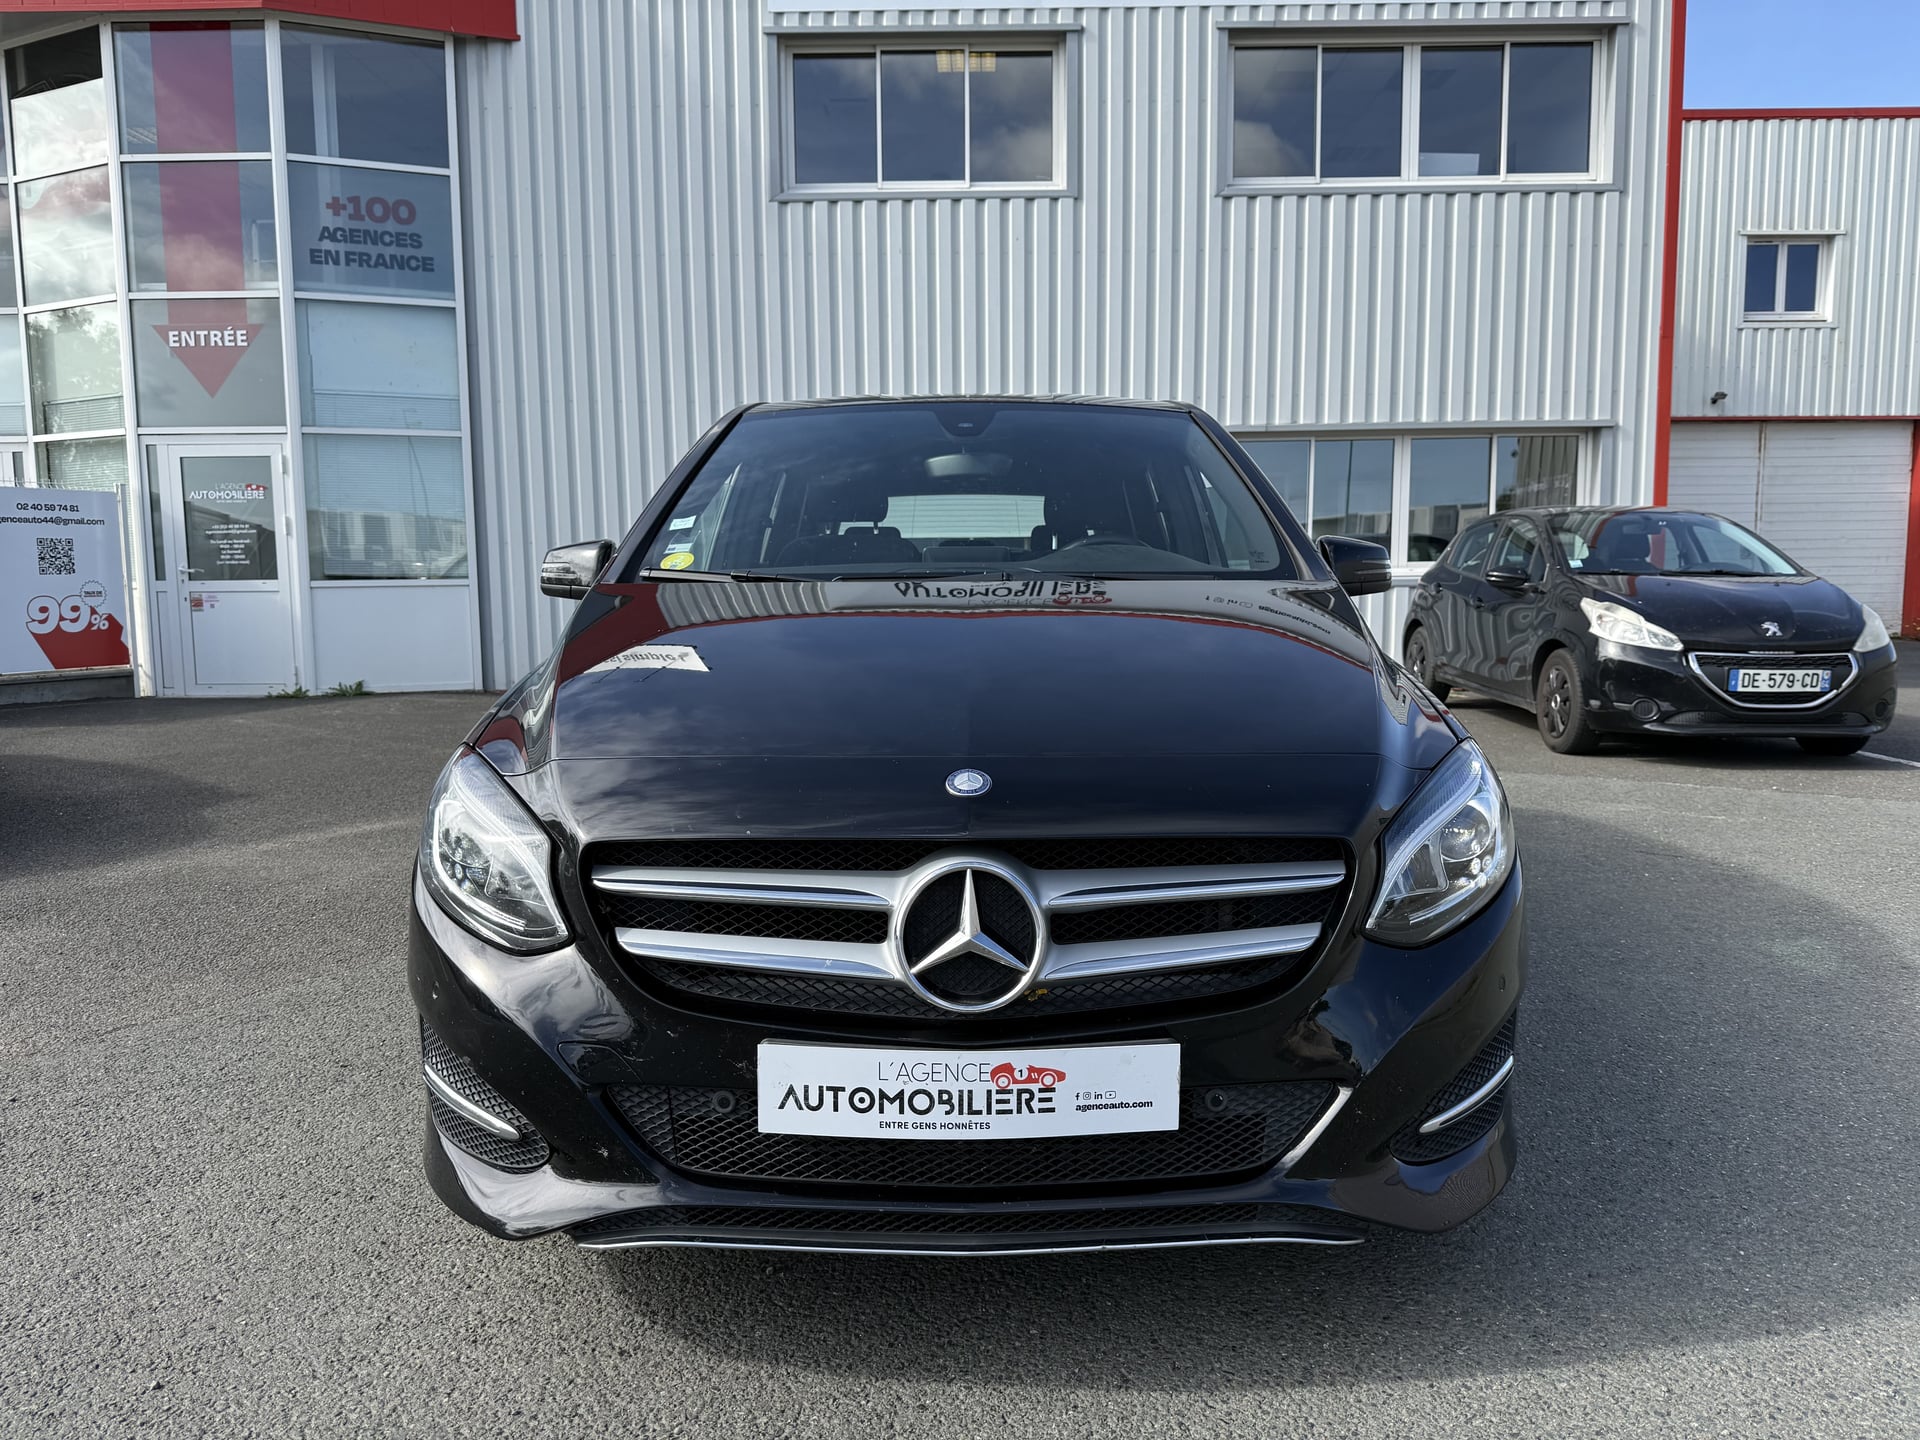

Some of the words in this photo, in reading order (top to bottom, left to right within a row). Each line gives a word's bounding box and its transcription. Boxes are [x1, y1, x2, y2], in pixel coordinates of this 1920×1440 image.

[326, 196, 416, 225] +100
[318, 226, 423, 249] AGENCES
[309, 248, 340, 266] EN
[344, 250, 435, 272] FRANCE
[168, 326, 249, 347] ENTRÉE
[16, 502, 29, 511] 02
[30, 503, 43, 511] 40
[44, 503, 56, 512] 59
[57, 504, 68, 512] 74
[69, 504, 80, 512] 81
[0, 516, 105, 526] enceauto44@gmail.com
[26, 595, 110, 634] 99%
[1741, 672, 1820, 689] DE-579-CD
[878, 1062, 991, 1083] L'AGENCE
[778, 1084, 1056, 1116] AUTOMOBILIERE
[1076, 1101, 1153, 1112] agenceauto.com
[879, 1121, 908, 1130] ENTRE
[911, 1121, 937, 1130] GENS
[940, 1119, 991, 1130] HONNÊTES
